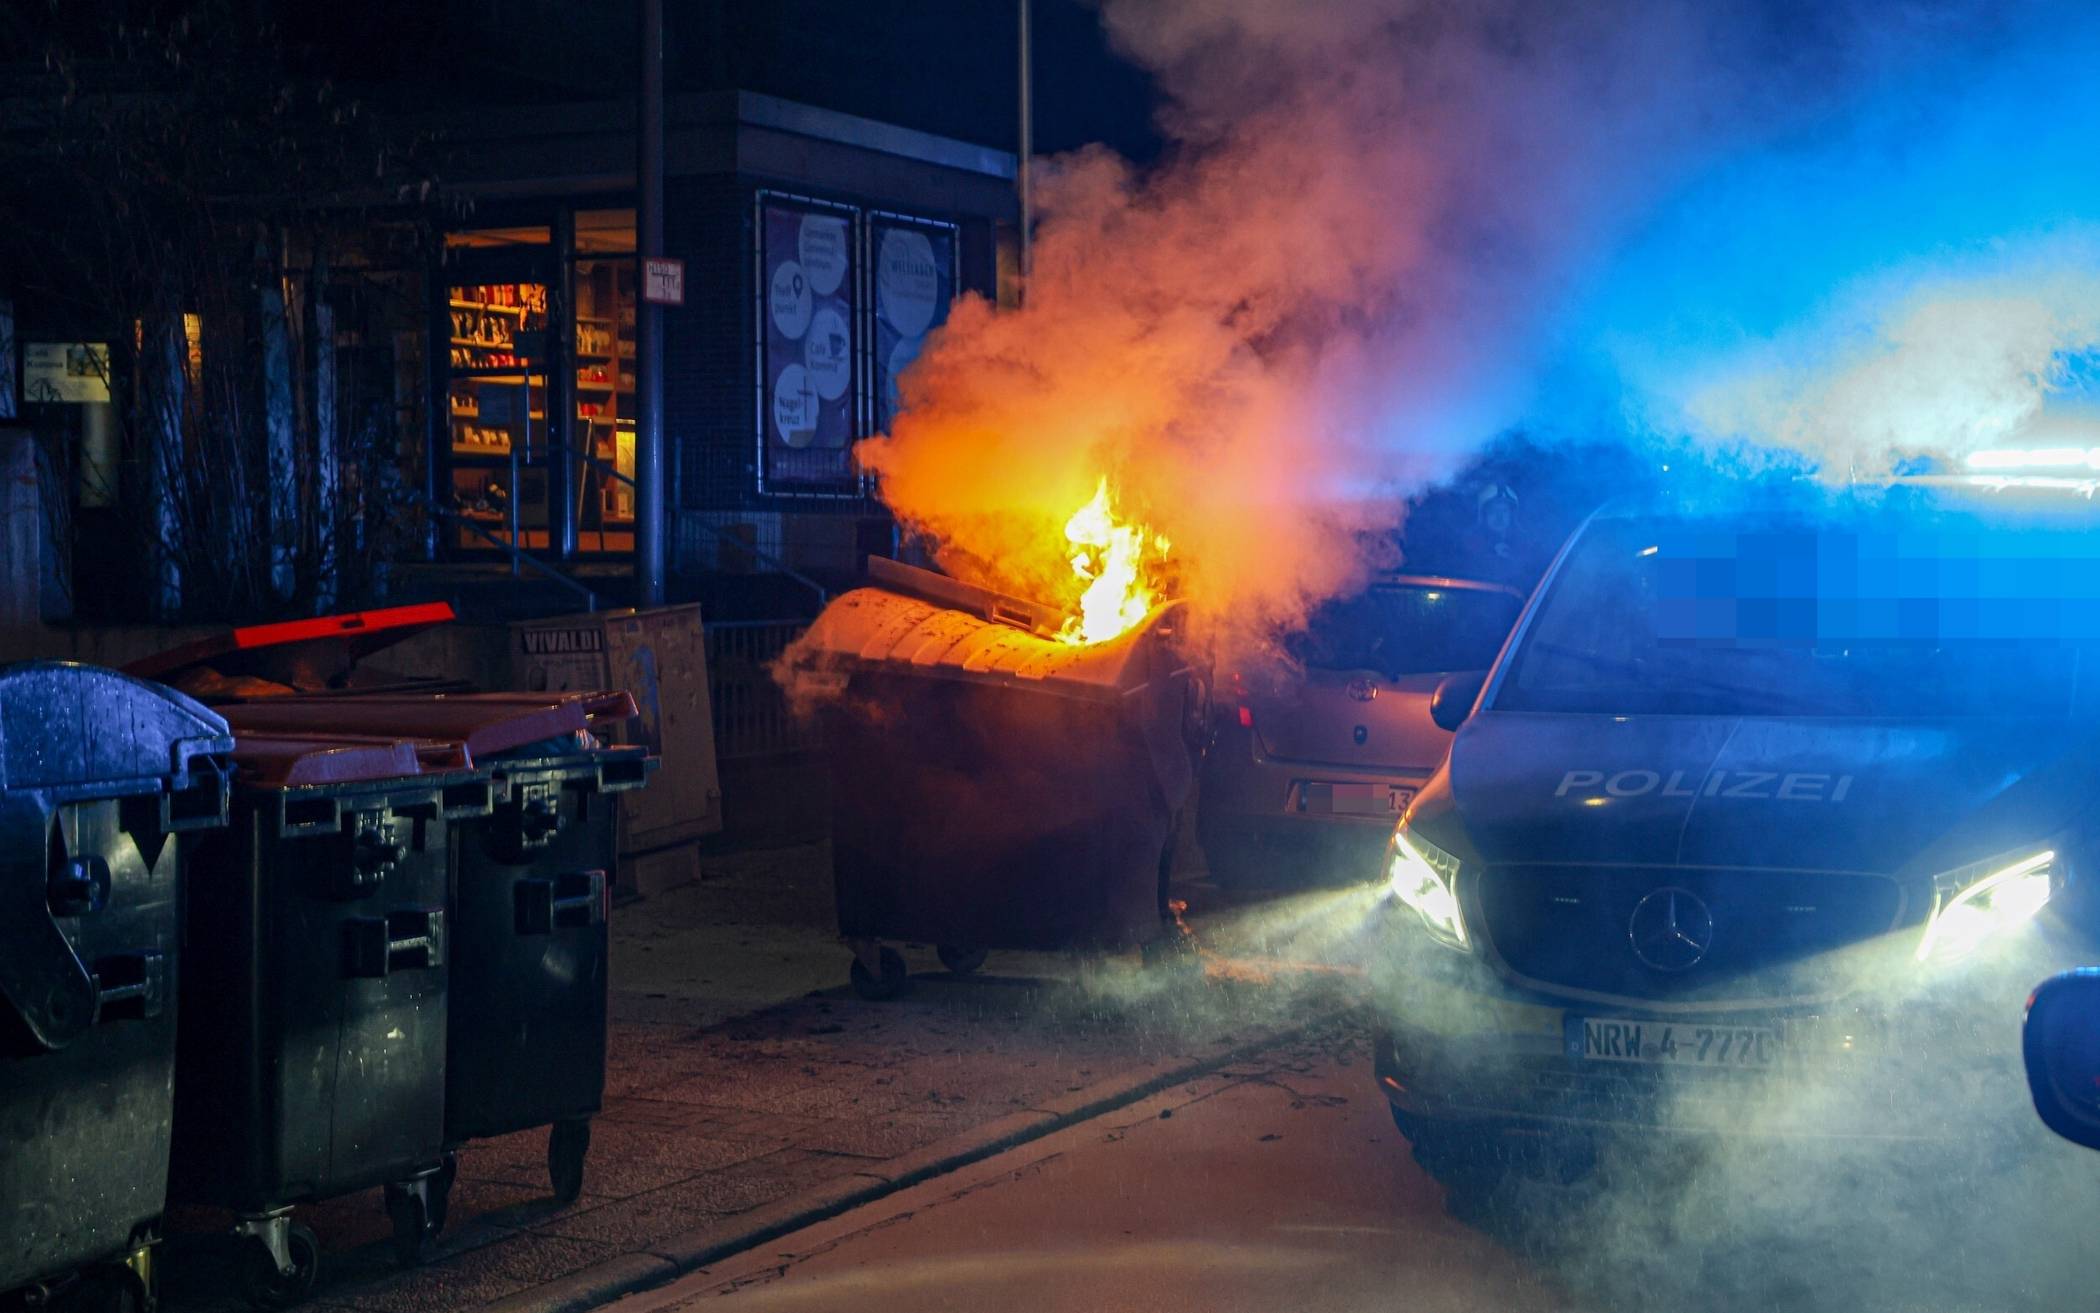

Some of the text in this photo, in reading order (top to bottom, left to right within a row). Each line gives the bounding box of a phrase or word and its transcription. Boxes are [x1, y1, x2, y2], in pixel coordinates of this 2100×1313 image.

[525, 630, 600, 653] VIVALDI
[1554, 769, 1854, 802] POLIZEI
[1389, 791, 1410, 811] 13
[1584, 1022, 1641, 1058] NRW
